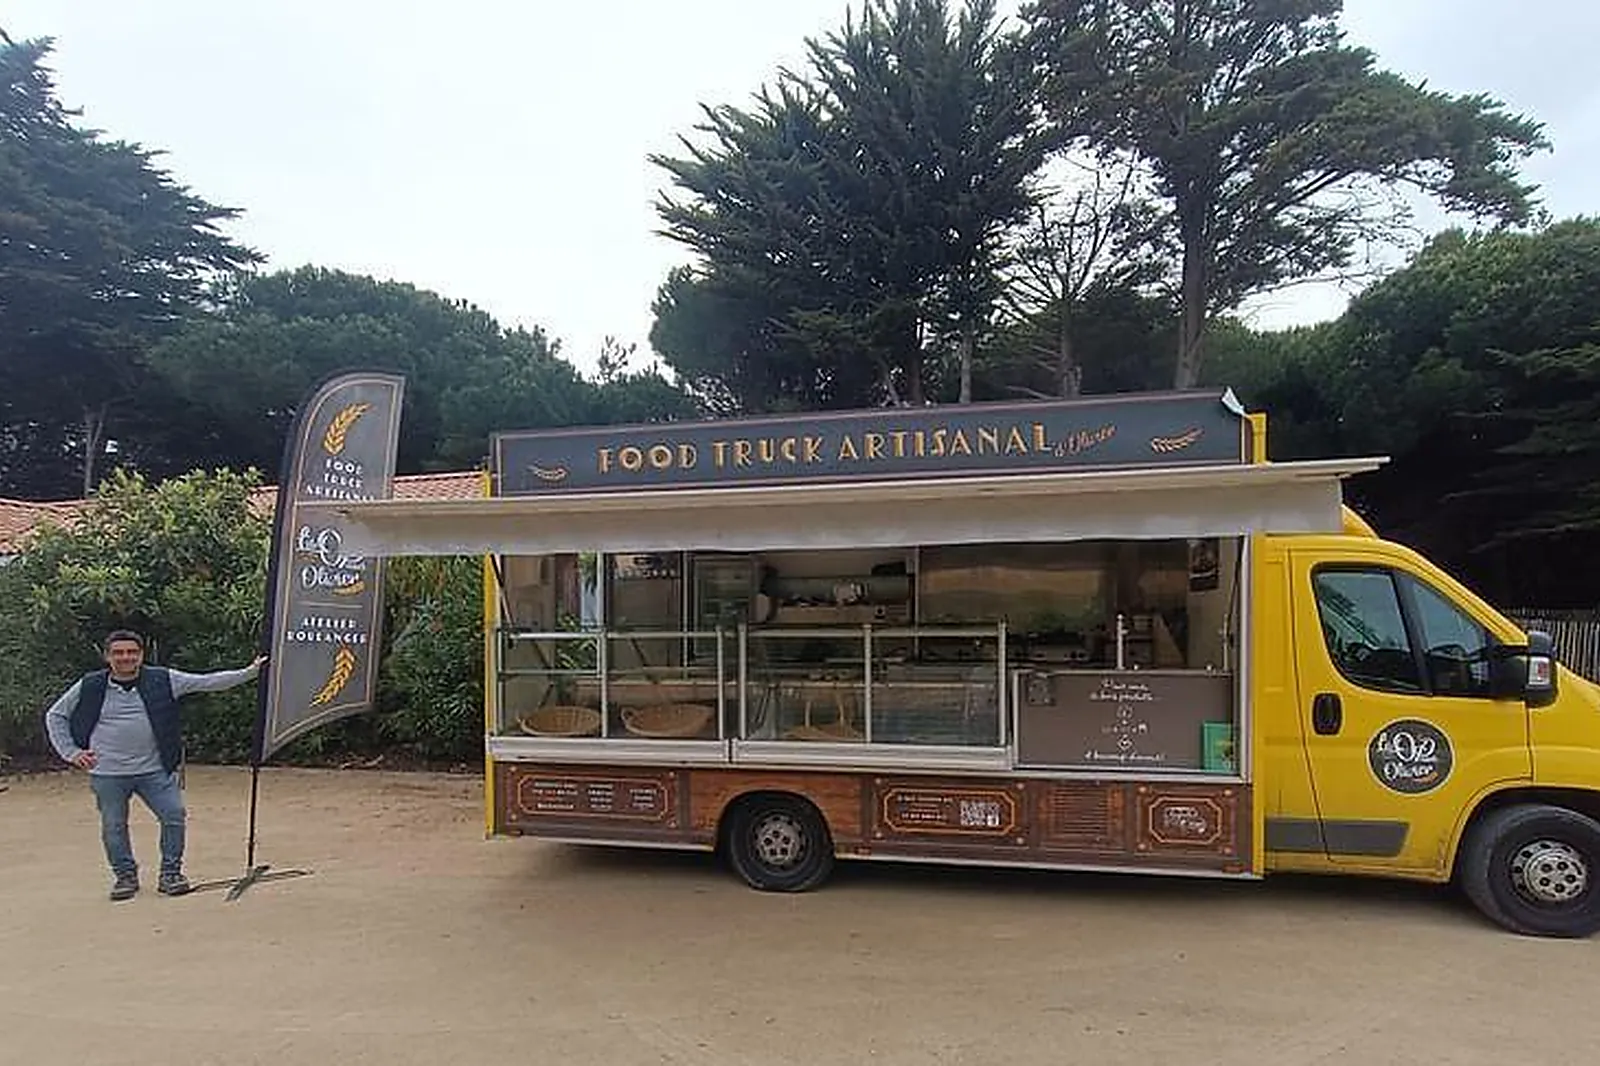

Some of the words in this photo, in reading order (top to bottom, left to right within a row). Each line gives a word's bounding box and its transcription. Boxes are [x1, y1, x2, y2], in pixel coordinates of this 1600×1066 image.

[598, 444, 698, 473] FOOD
[712, 436, 823, 468] TRUCK
[838, 422, 1052, 461] ARTISANAL
[326, 458, 362, 475] FOOD
[324, 473, 361, 489] TRUCK
[303, 617, 358, 629] ATELIER
[286, 631, 368, 644] BOULANGER
